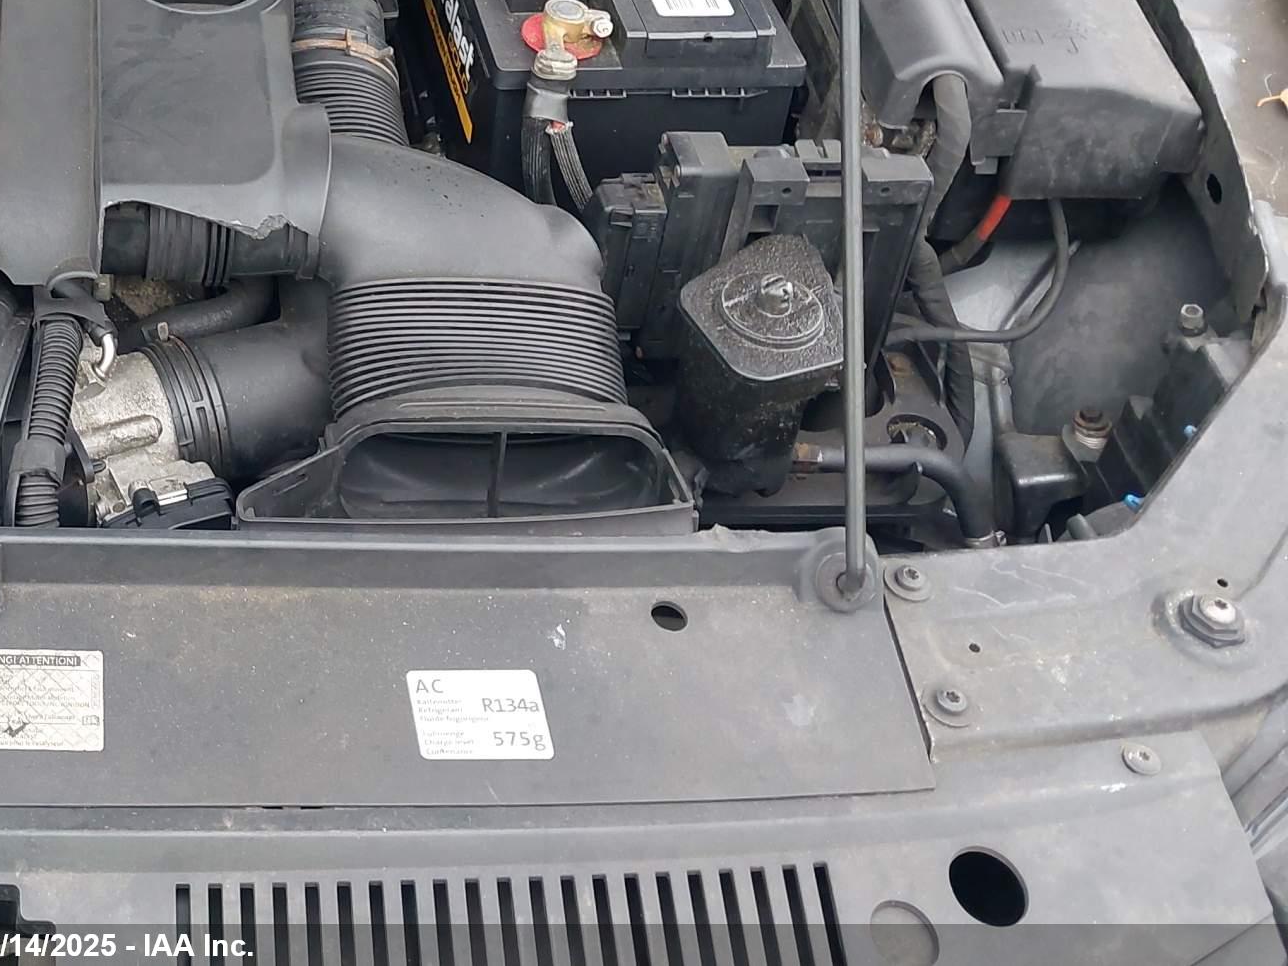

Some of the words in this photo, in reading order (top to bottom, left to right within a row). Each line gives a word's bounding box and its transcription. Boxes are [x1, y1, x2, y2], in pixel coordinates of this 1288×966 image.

[18, 656, 78, 666] ATTENTION!
[416, 679, 443, 694] AC
[482, 698, 540, 713] R134a
[493, 731, 546, 752] 575g
